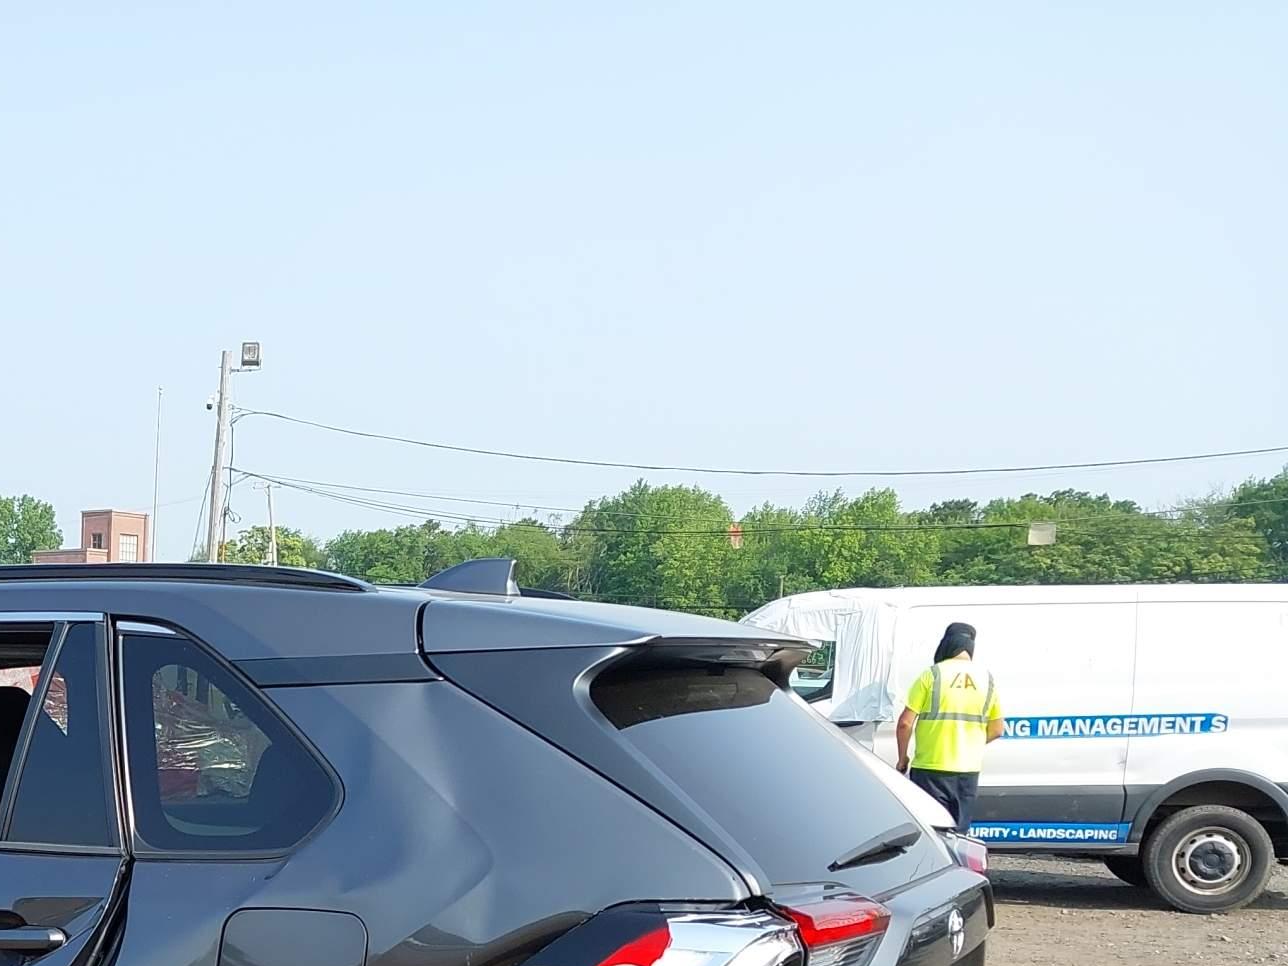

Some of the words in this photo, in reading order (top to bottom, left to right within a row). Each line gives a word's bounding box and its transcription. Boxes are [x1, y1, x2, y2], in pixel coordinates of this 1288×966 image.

[1001, 720, 1031, 737] NG
[1037, 716, 1208, 737] MANAGEMENT
[1210, 715, 1225, 732] S
[968, 827, 1011, 839] URITY
[1019, 826, 1118, 841] LANDSCAPING
